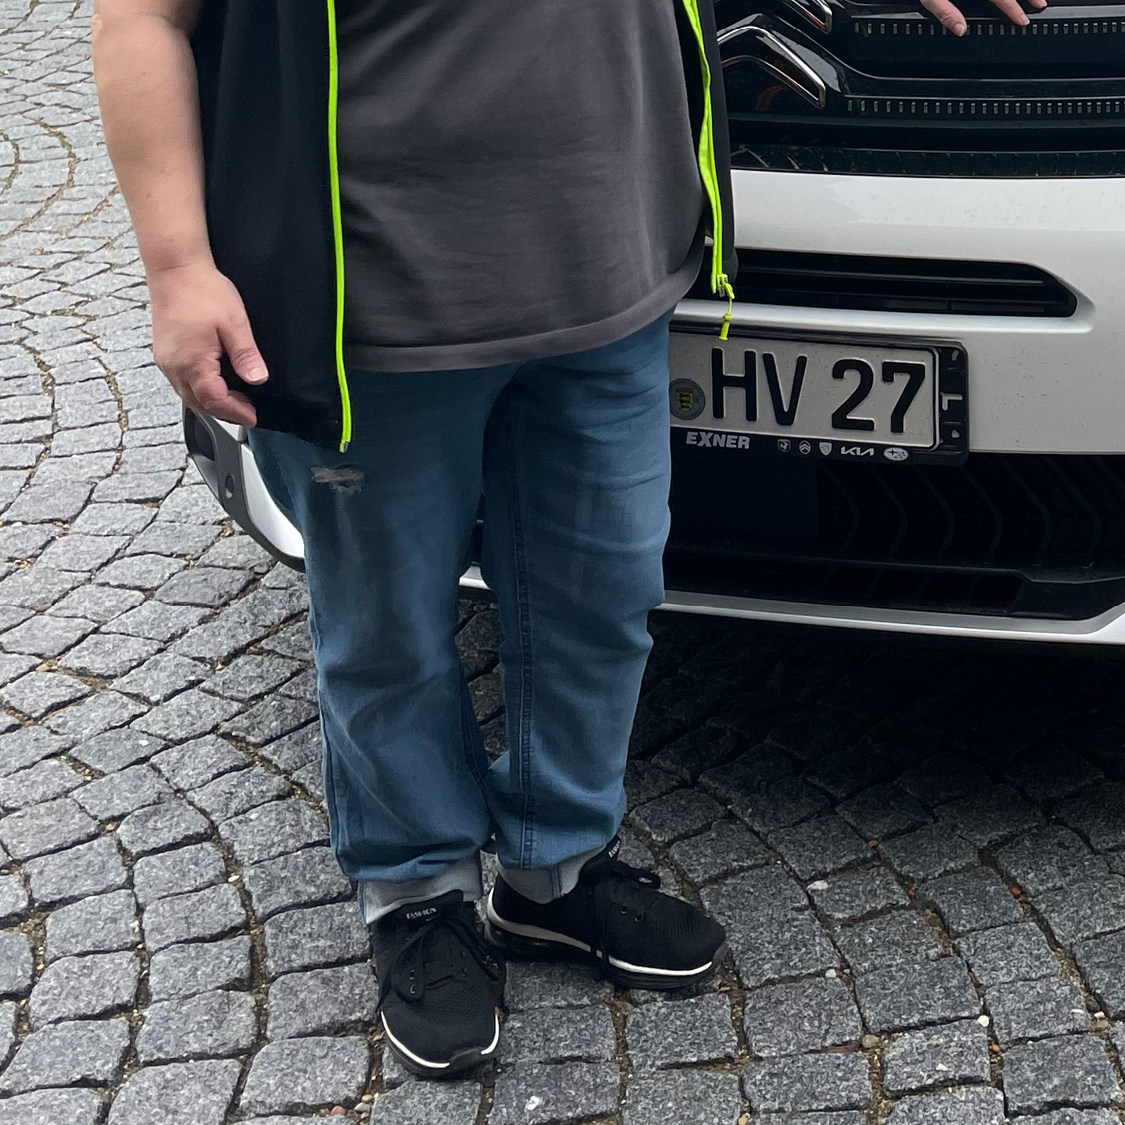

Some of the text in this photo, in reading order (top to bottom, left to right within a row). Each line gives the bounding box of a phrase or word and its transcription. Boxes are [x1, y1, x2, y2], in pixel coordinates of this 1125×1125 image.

[711, 346, 808, 426] HV
[831, 356, 927, 434] 27
[686, 431, 751, 450] EXNER
